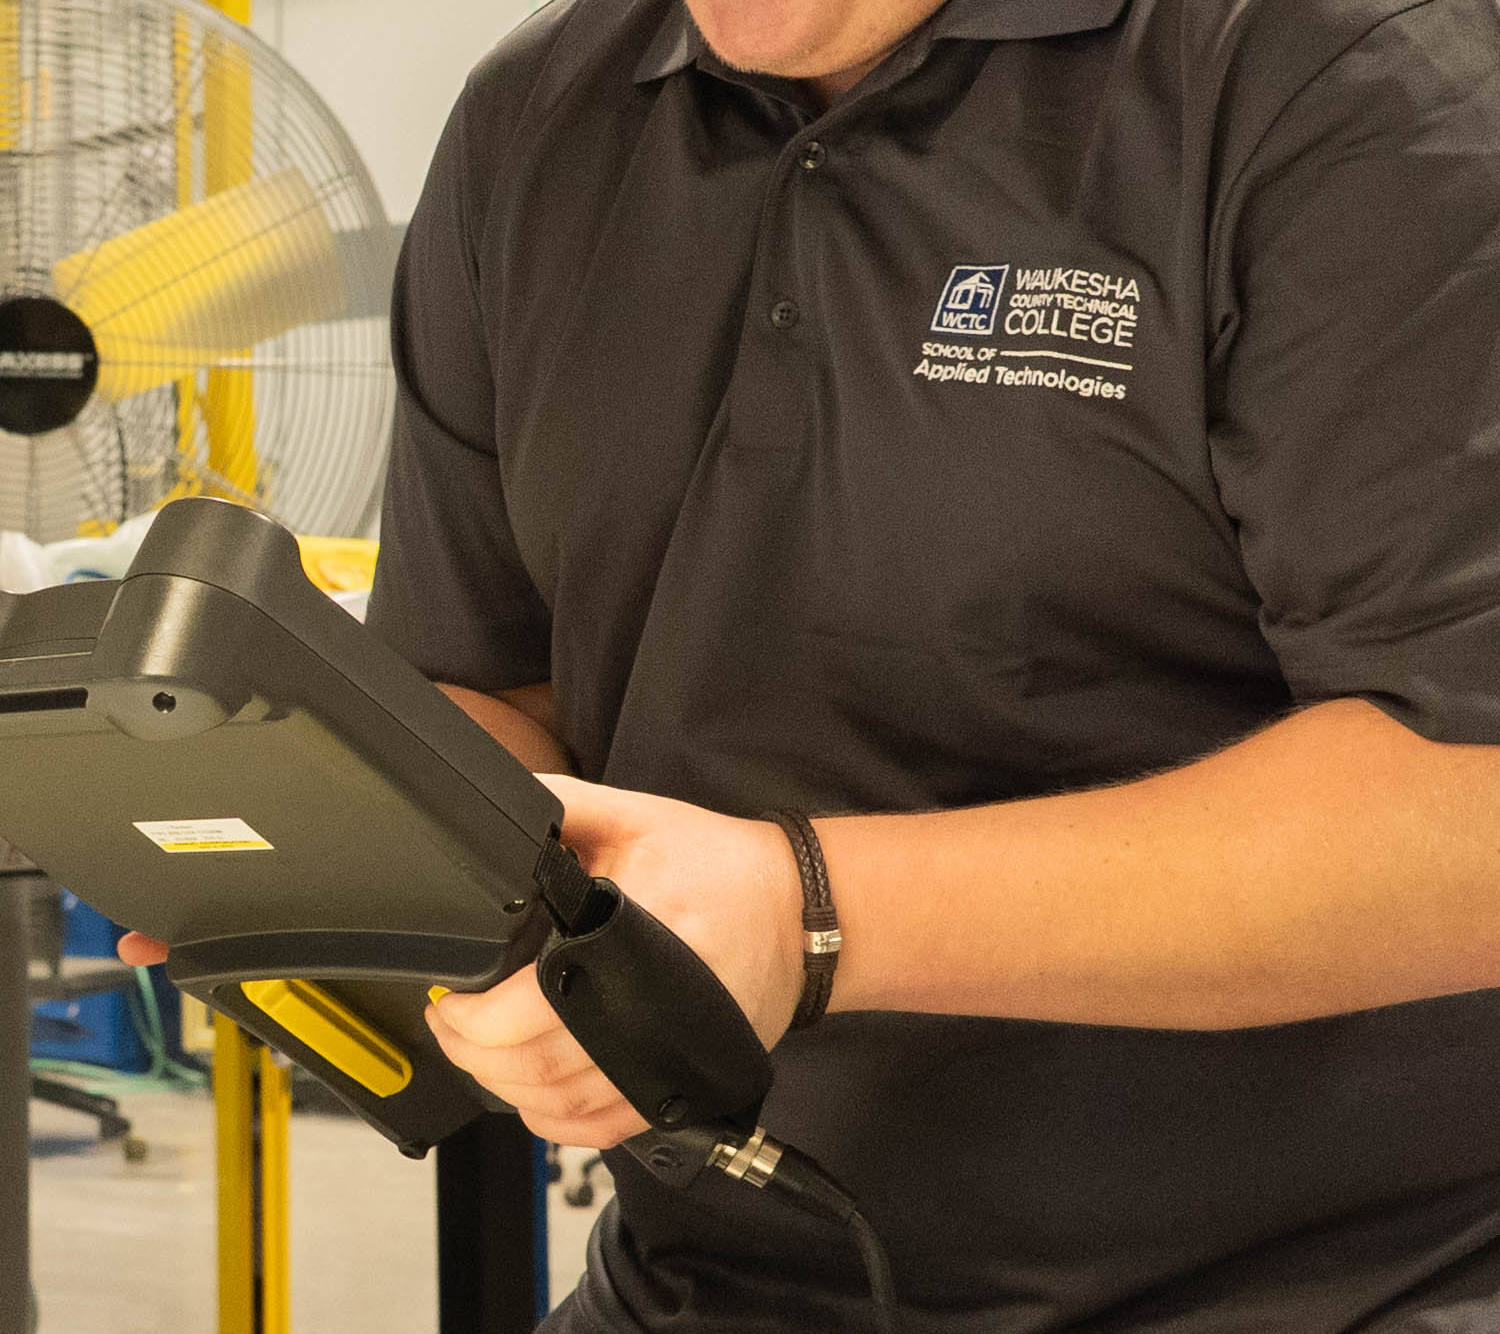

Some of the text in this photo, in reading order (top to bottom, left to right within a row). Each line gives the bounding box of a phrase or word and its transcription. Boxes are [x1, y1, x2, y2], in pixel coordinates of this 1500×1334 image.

[1015, 267, 1141, 302] WAUKESHA
[941, 311, 988, 330] WCTC
[1009, 293, 1138, 320] COUNTY TECHNICAL
[1005, 309, 1137, 347] COLLEGE
[921, 341, 998, 361] SCHOOL OF
[912, 359, 1127, 400] Applied Technologies
